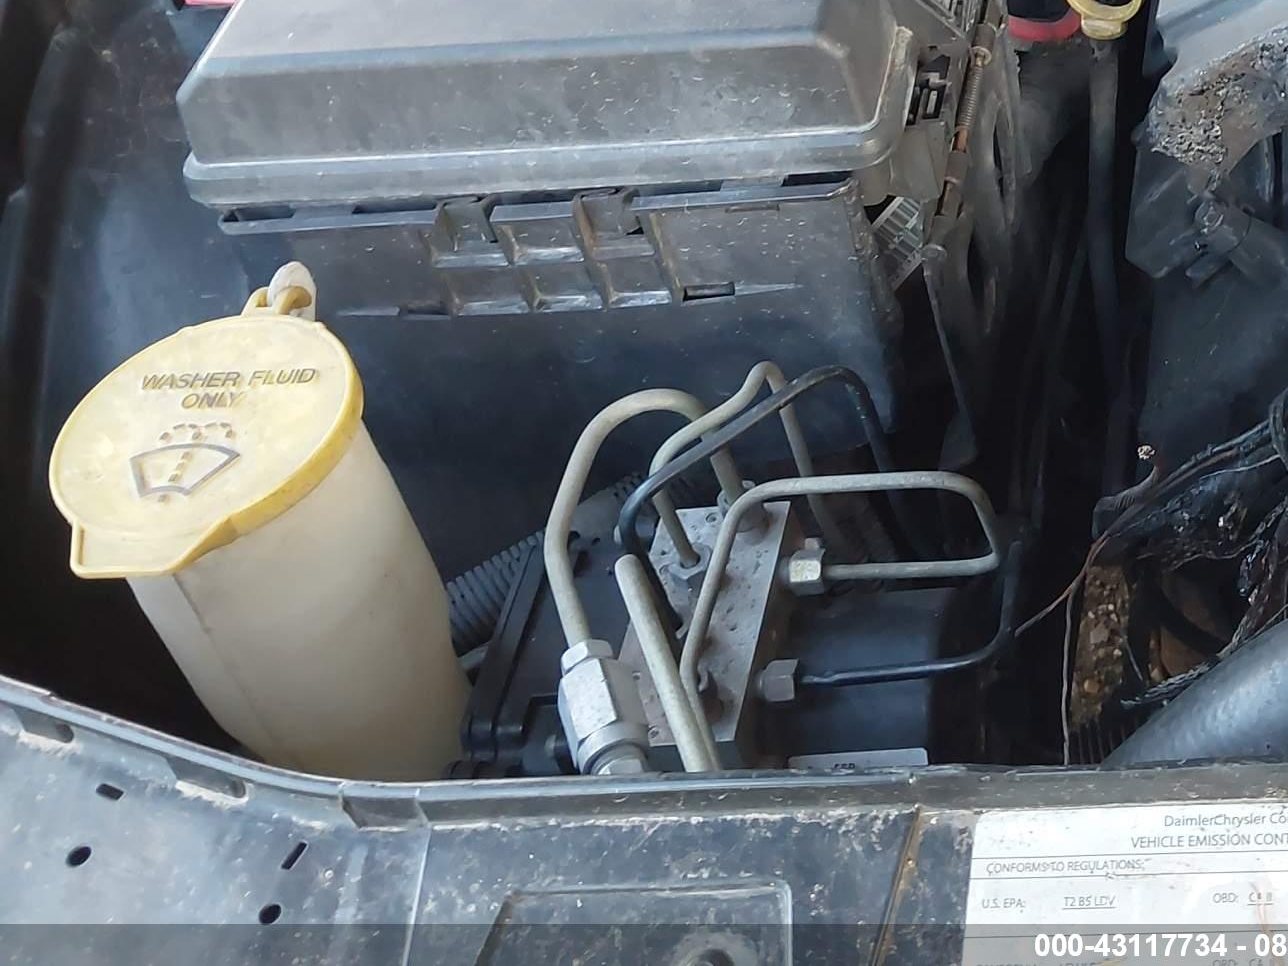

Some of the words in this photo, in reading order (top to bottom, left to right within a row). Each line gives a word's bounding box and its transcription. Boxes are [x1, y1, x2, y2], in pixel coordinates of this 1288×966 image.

[141, 371, 240, 390] WASHER
[248, 368, 318, 386] FLUID
[181, 392, 243, 409] ONLY
[1164, 813, 1265, 827] DaimlerChrysler
[1131, 835, 1184, 848] VEHICLE
[1188, 834, 1251, 847] EMISSION
[986, 862, 1047, 874] CONFORMS
